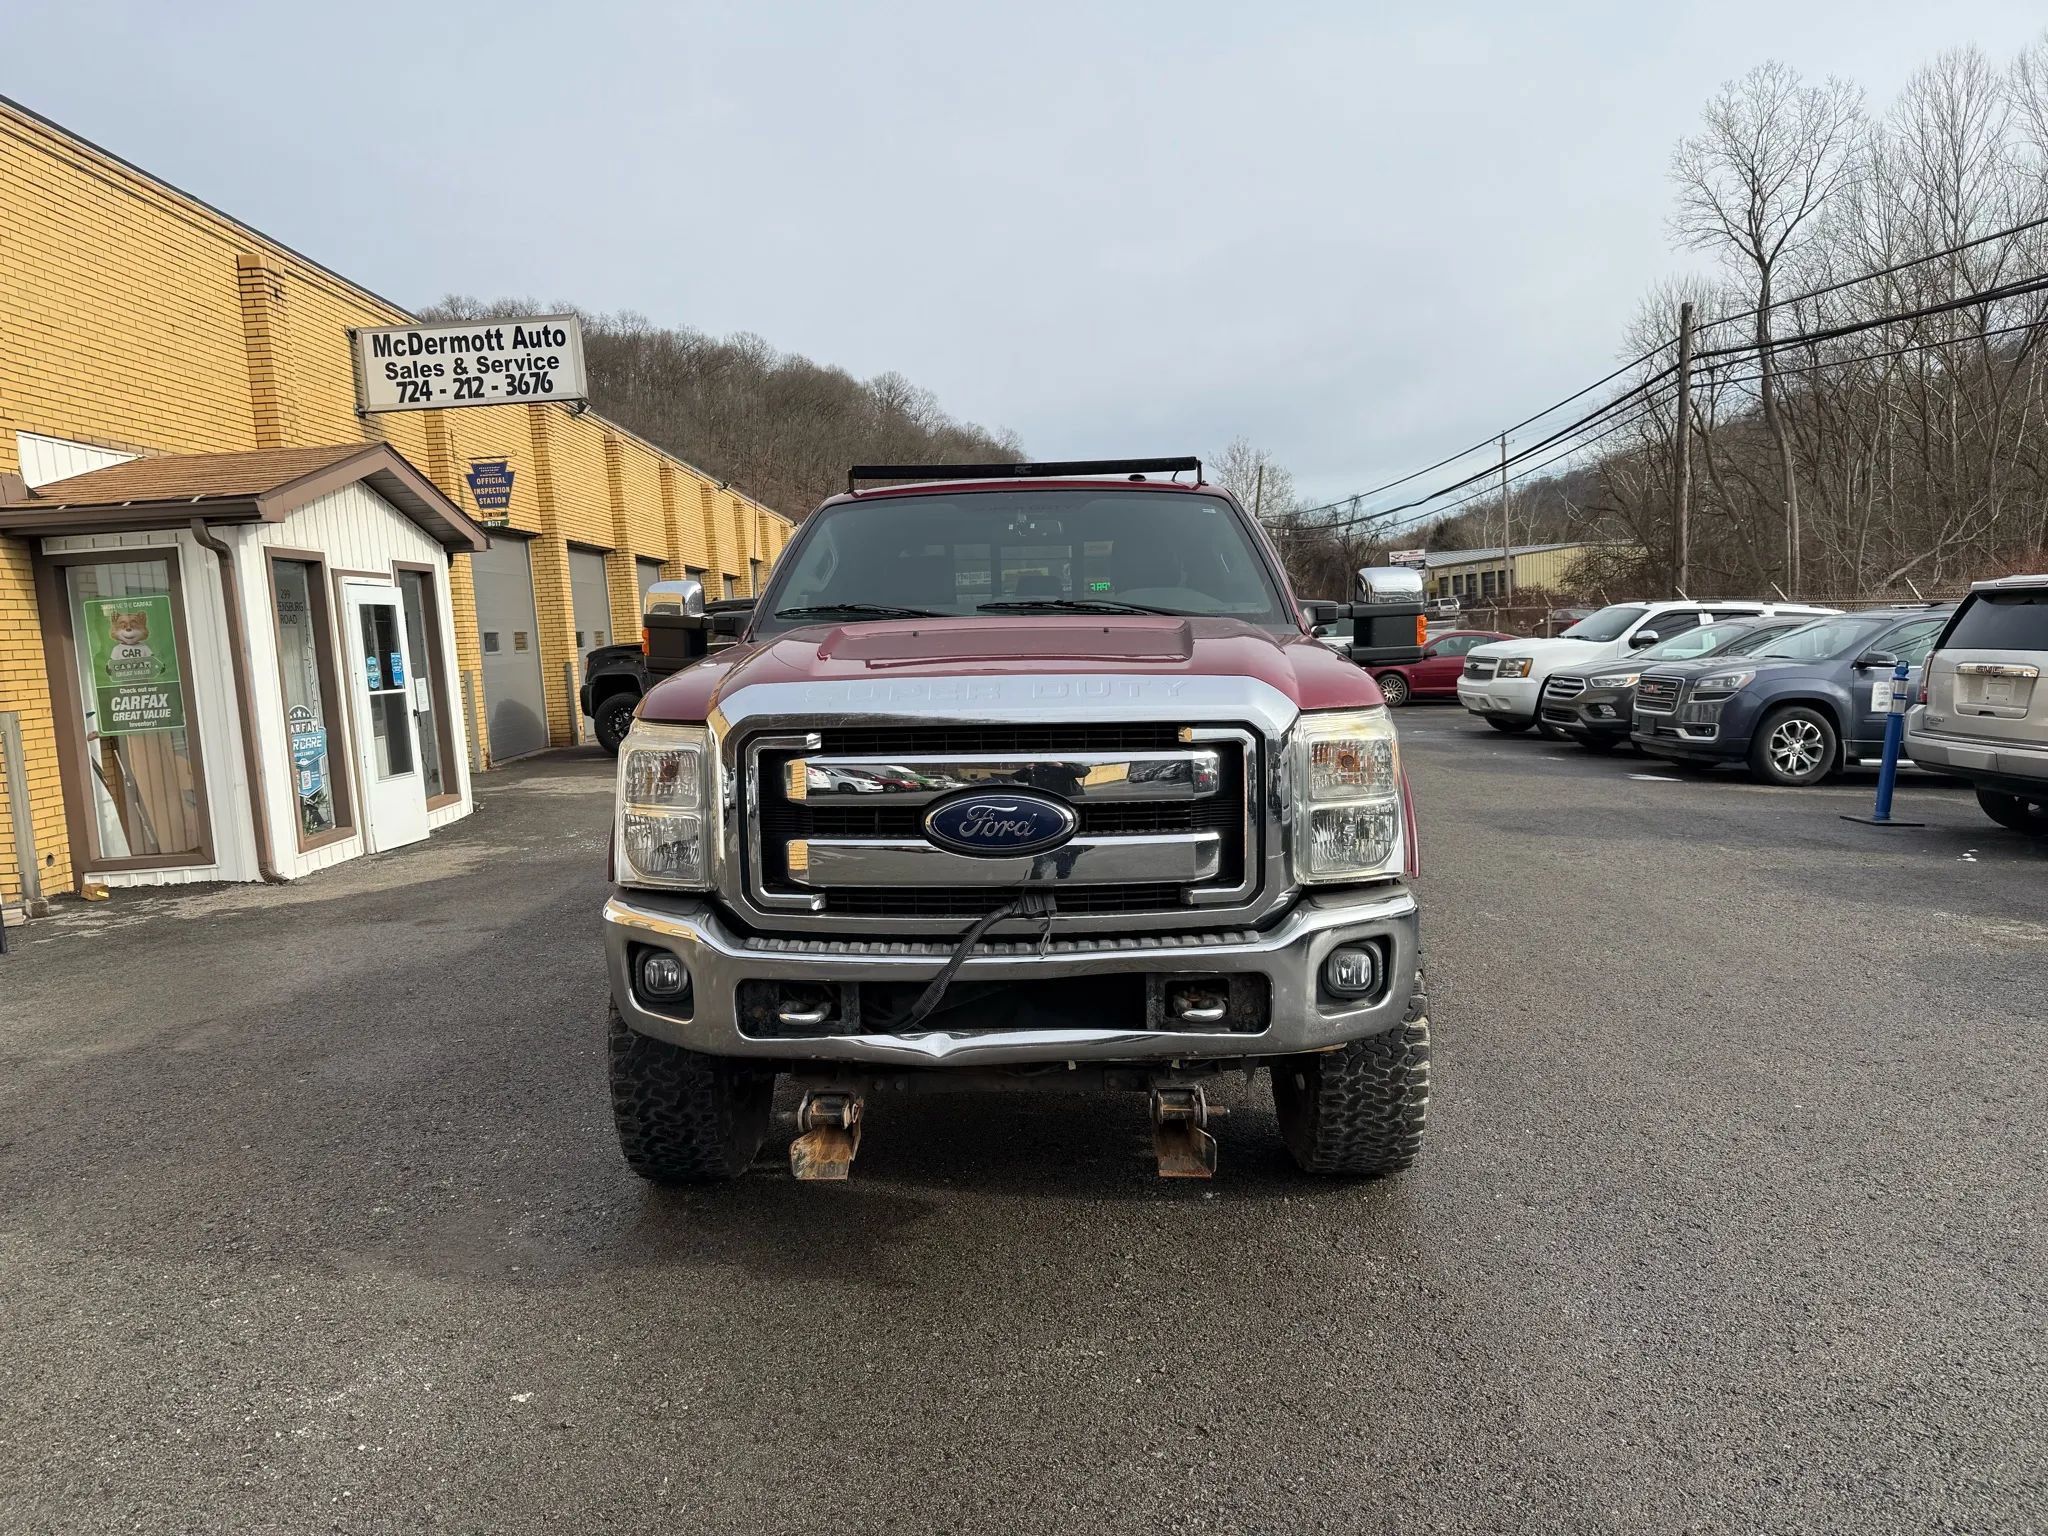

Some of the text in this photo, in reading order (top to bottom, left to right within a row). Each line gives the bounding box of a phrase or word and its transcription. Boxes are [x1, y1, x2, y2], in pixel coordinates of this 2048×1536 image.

[372, 324, 566, 358] McDermott Auto
[385, 352, 560, 381] Sales & Service
[396, 380, 432, 404] 724
[452, 376, 485, 400] 212
[505, 371, 554, 396] 3676
[1014, 465, 1032, 474] RC
[476, 477, 507, 485] OFFICIAL
[473, 486, 511, 495] INSPECTION
[479, 496, 507, 505] STATION
[277, 601, 304, 612] EENSBURG
[280, 614, 298, 625] ROAD
[121, 648, 142, 658] CAR
[1976, 665, 2003, 674] GMC
[1032, 679, 1188, 699] DUTY
[111, 693, 168, 711] CARFAX
[112, 708, 171, 722] GREAT VALUE
[129, 720, 158, 728] Inventory!
[290, 721, 319, 734] ARFAX
[300, 735, 322, 750] CARE
[958, 805, 1038, 838] Ford
